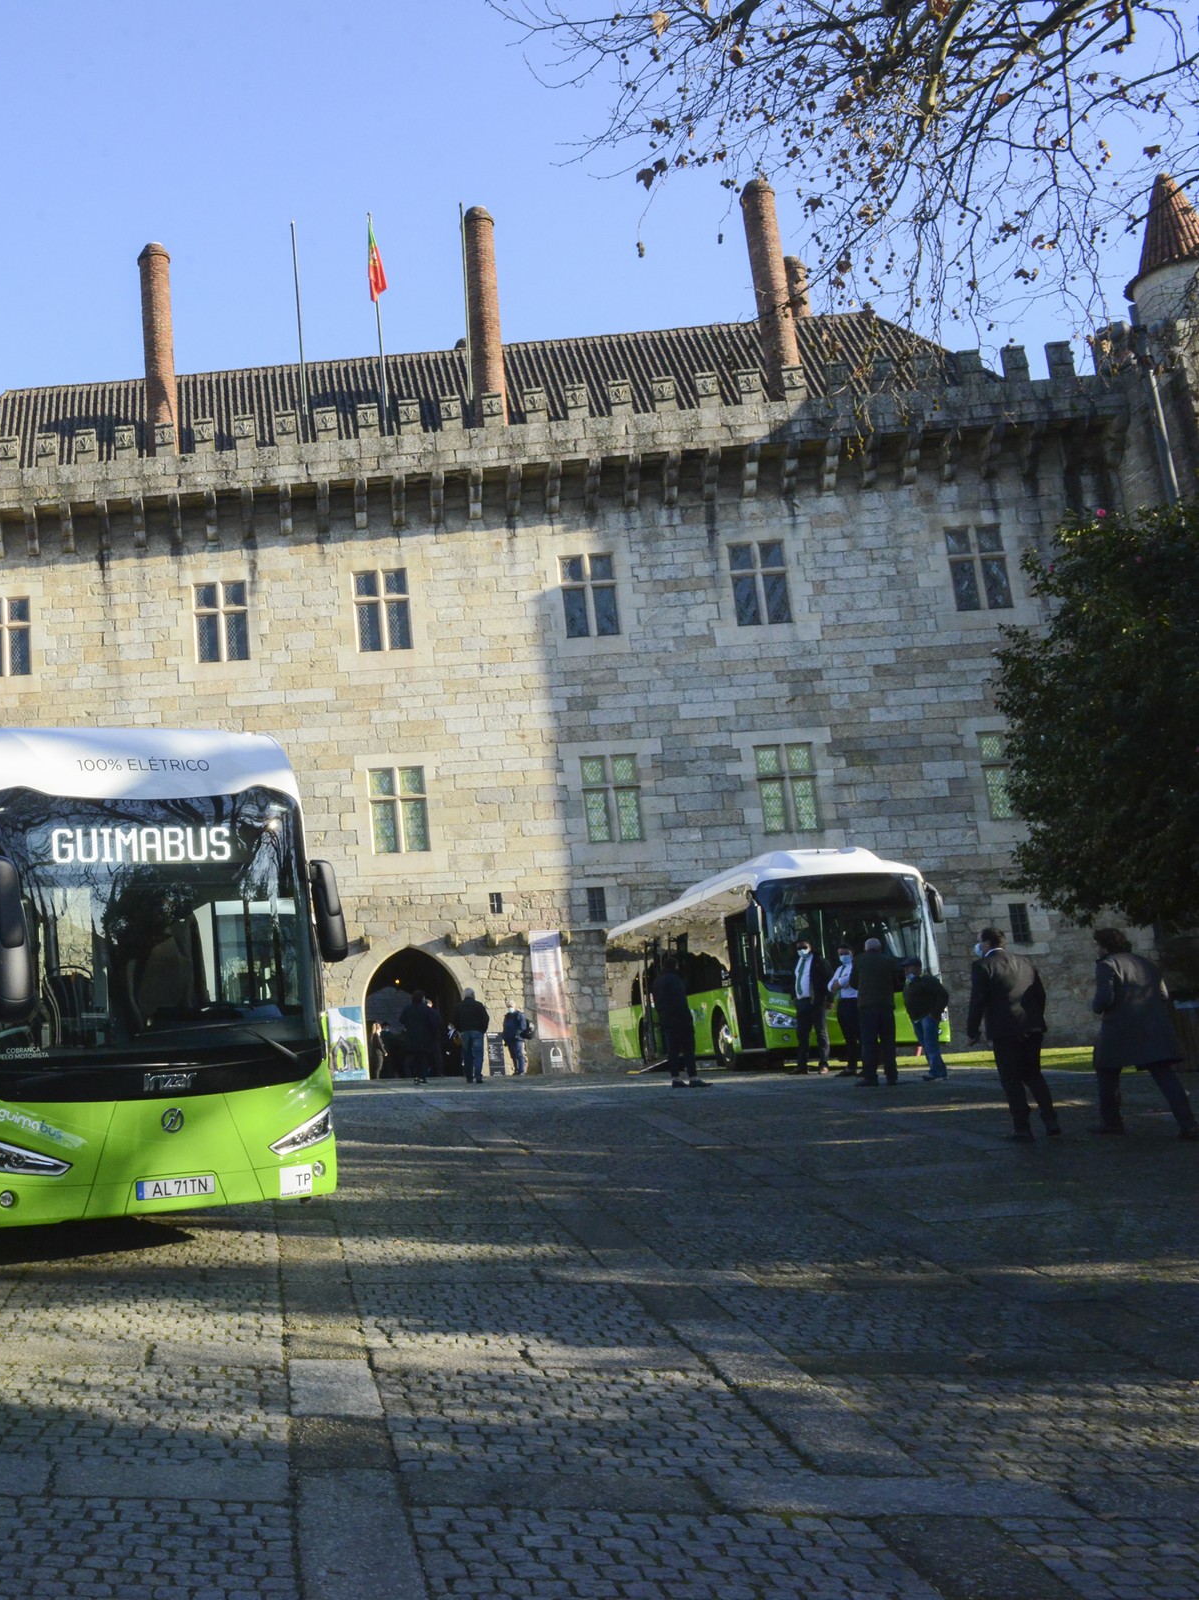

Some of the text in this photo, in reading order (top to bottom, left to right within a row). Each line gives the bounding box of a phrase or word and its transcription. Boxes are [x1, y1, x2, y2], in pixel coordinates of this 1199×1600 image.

[76, 756, 210, 772] 100% ELÉTRICO
[51, 826, 232, 864] GUIMABUS
[6, 1046, 41, 1055] COBRANÇA
[14, 1052, 50, 1060] MOTORISTA
[295, 1172, 311, 1187] TP
